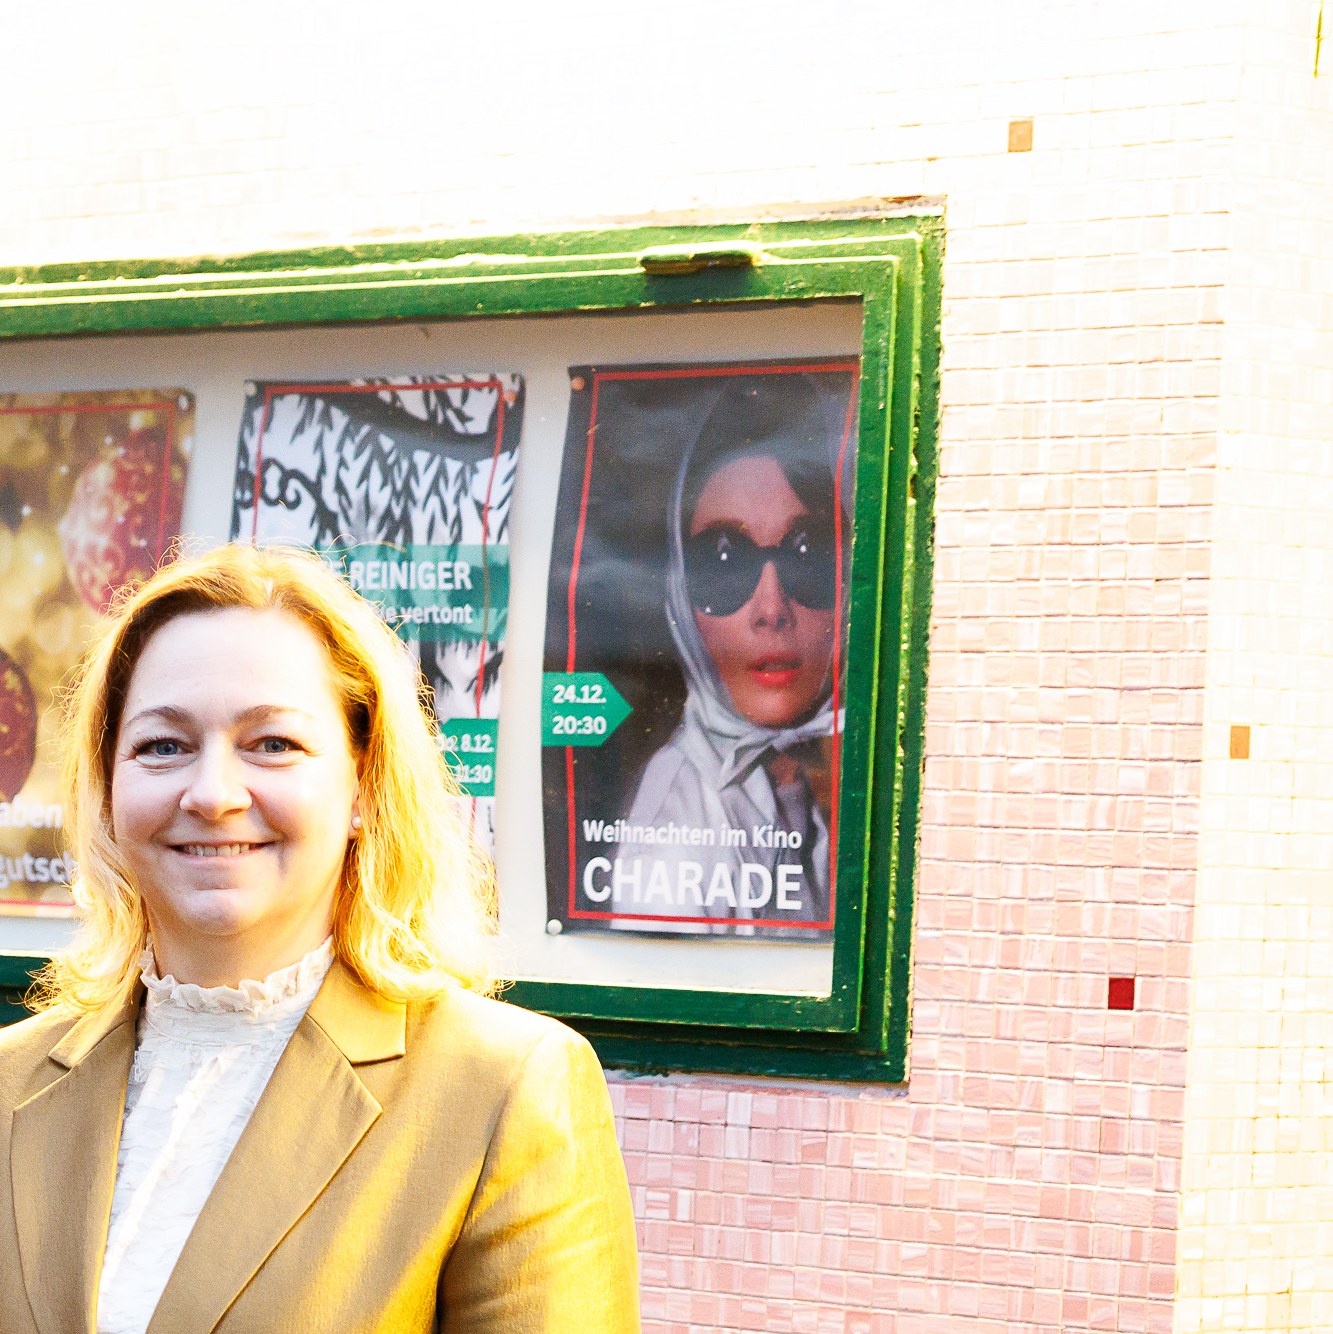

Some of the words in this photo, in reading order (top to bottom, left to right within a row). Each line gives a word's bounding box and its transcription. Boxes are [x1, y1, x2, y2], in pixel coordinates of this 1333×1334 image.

[349, 561, 473, 590] REINIGER
[400, 604, 473, 624] vertont
[552, 684, 607, 703] 24.12.
[552, 715, 607, 735] 20:30
[461, 734, 494, 753] 8.12.
[583, 819, 715, 846] Weihnachten
[720, 823, 747, 848] im
[752, 825, 802, 849] Kino
[583, 857, 803, 910] CHARADE
